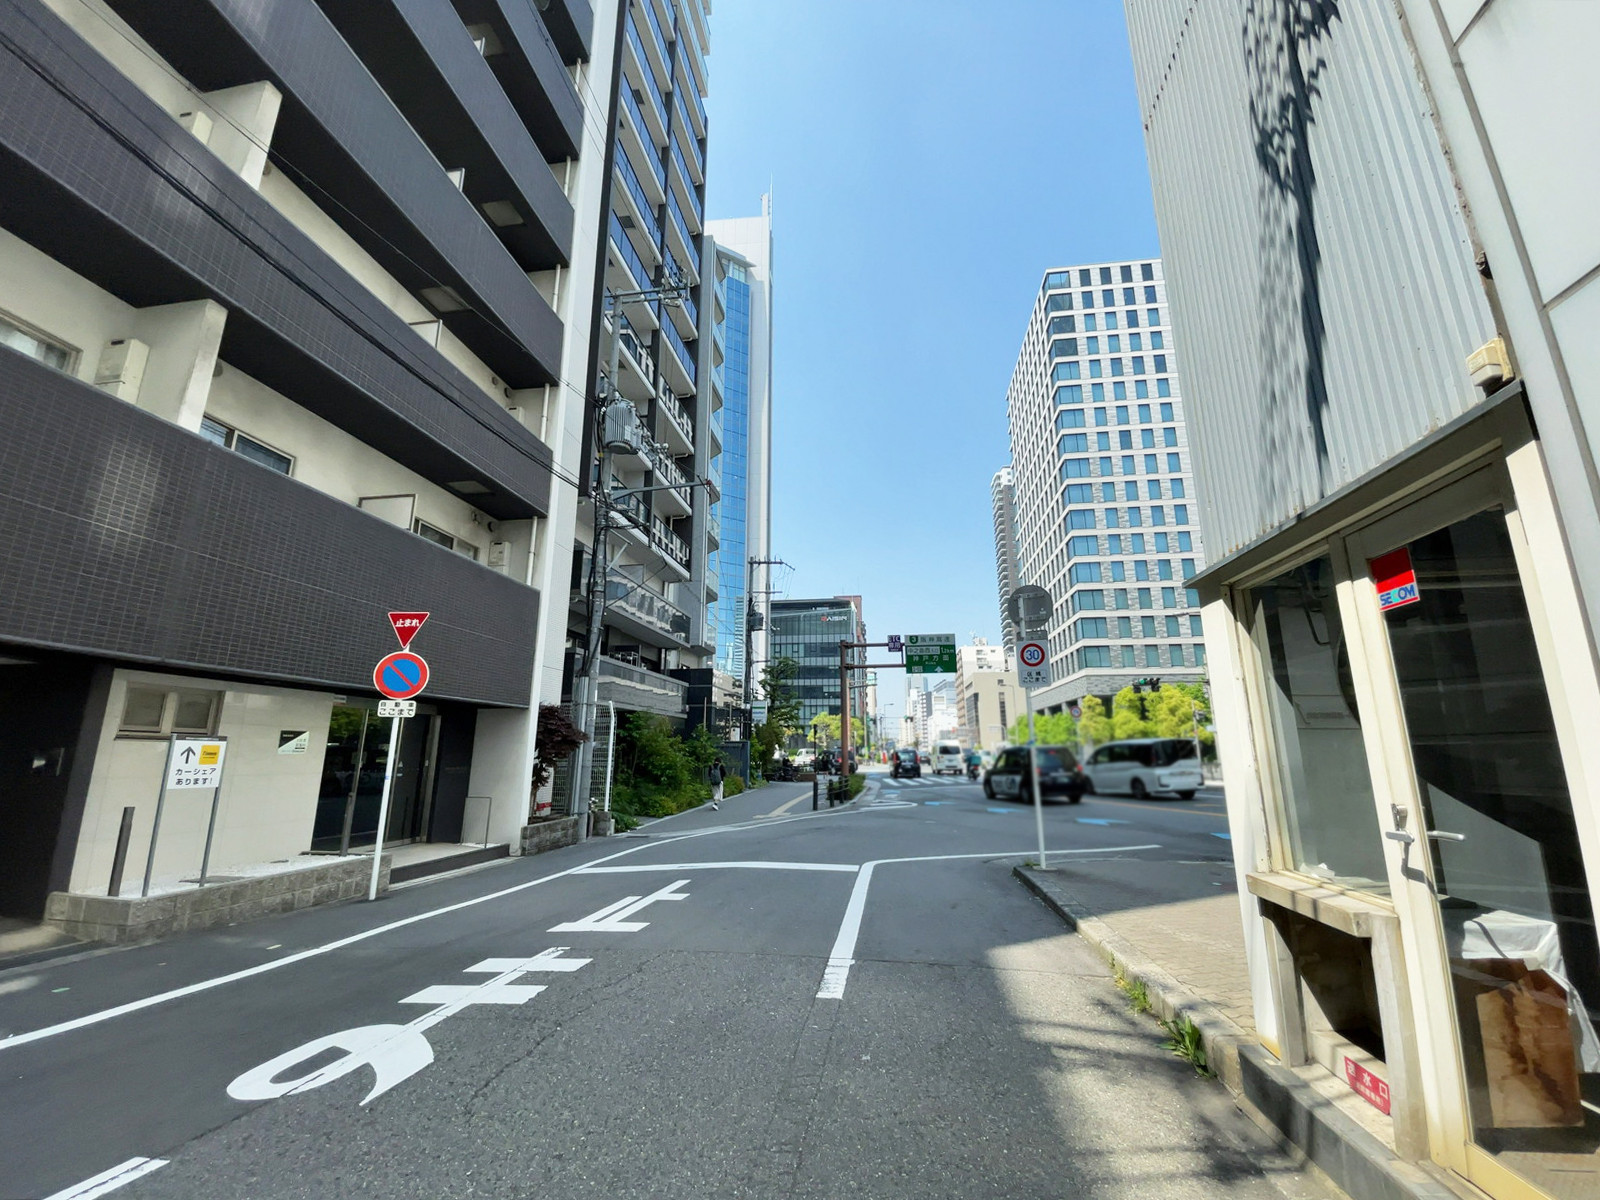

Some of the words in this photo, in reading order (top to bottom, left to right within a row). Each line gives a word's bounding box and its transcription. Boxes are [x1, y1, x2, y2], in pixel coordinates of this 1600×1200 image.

[1380, 585, 1415, 606] SECOM
[395, 618, 420, 628] 止まれ
[1025, 649, 1040, 661] 30
